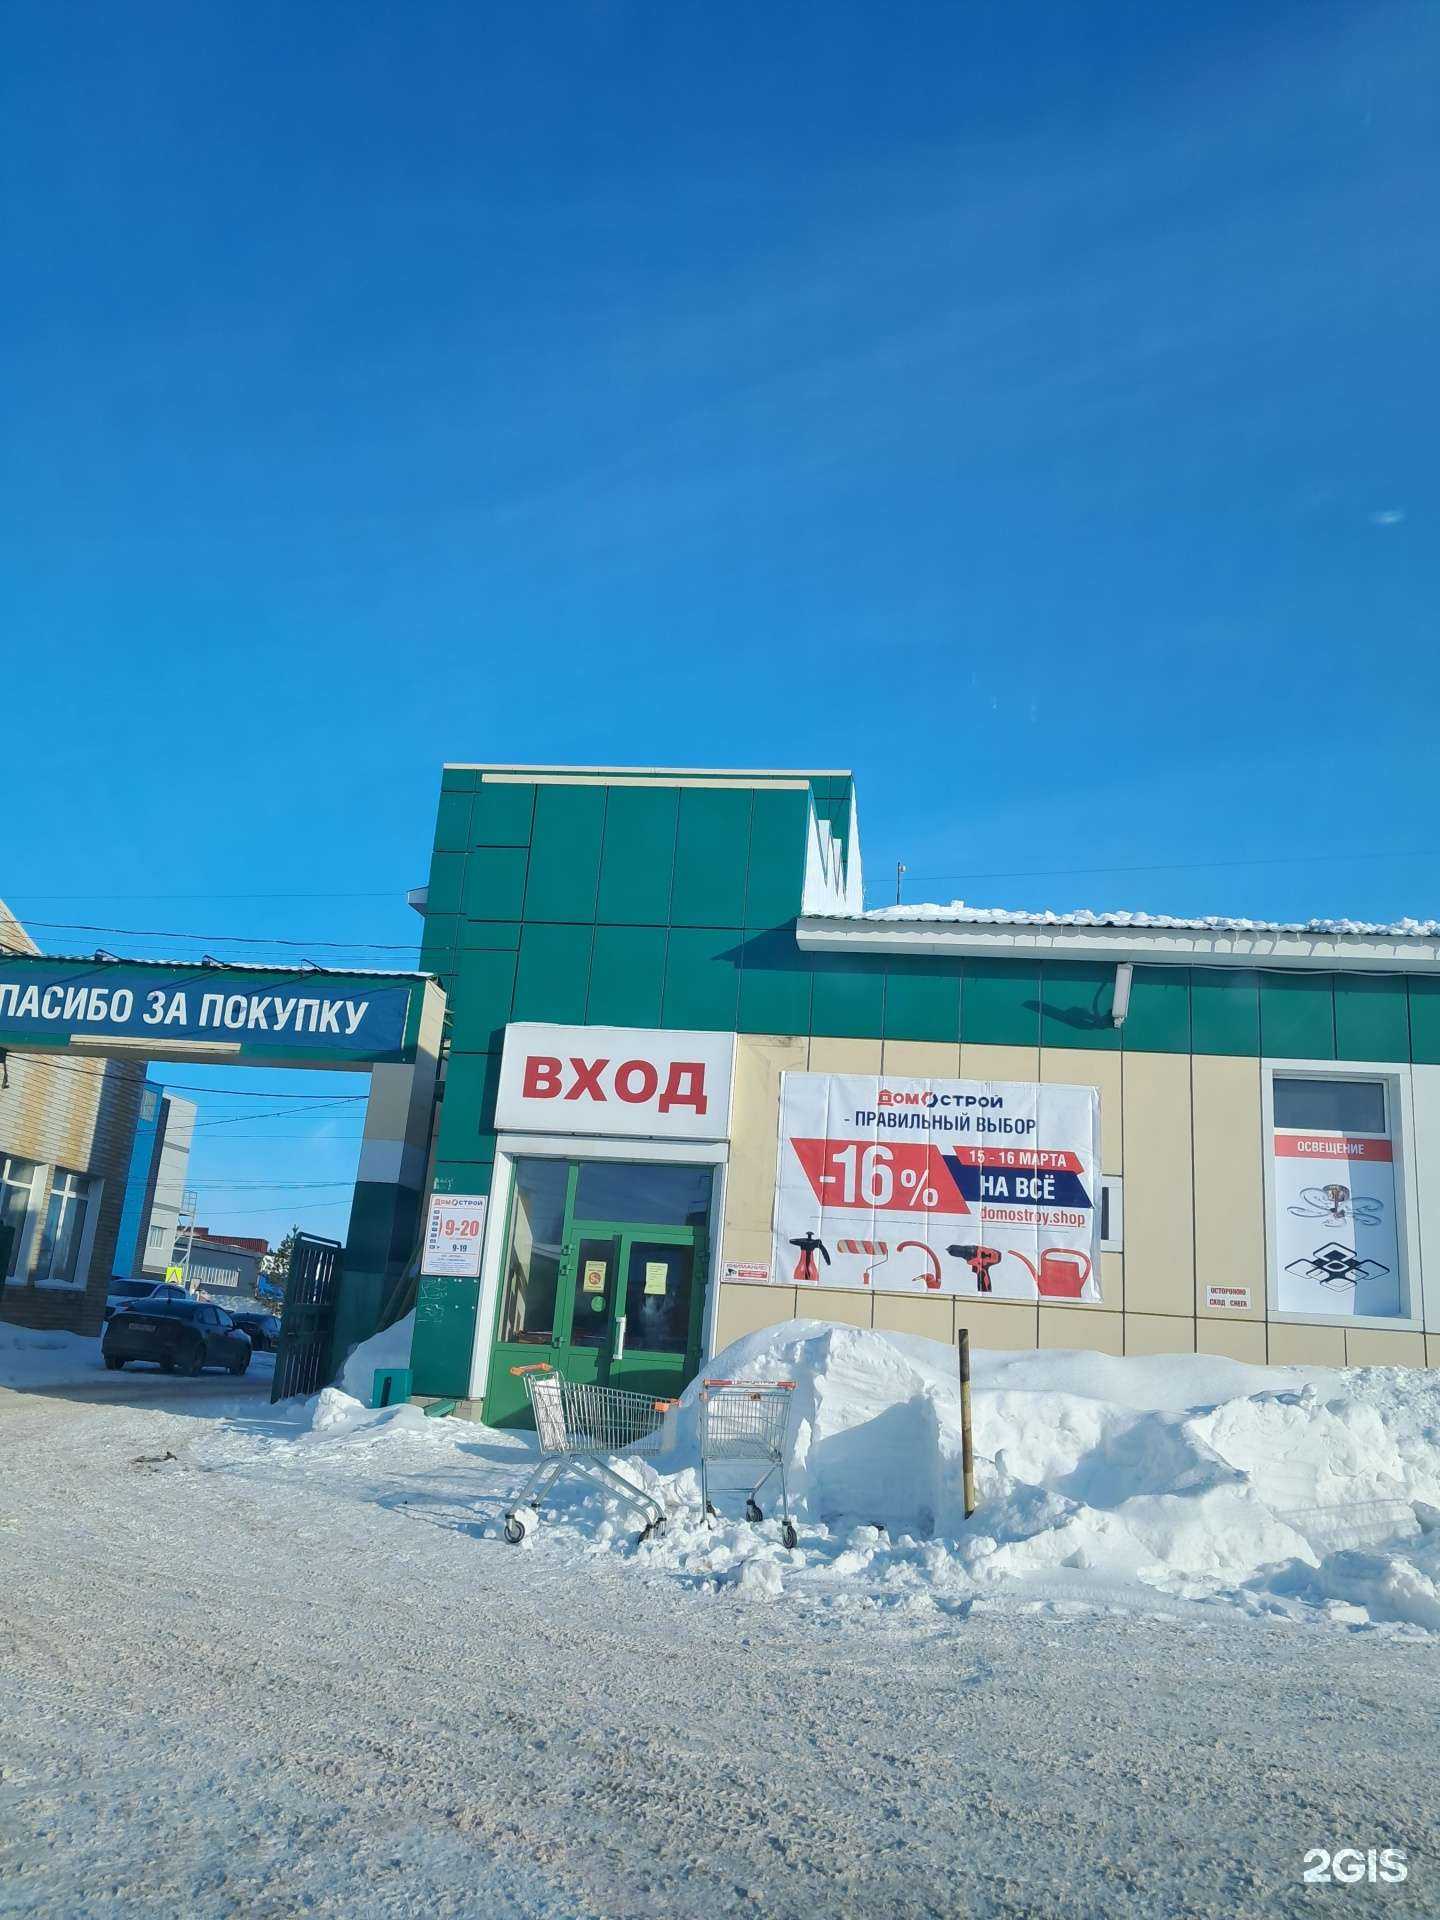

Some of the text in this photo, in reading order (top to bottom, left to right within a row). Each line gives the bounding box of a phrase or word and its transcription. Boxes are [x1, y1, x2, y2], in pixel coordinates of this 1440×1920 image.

[143, 990, 188, 1025] ЗА
[199, 993, 369, 1035] ПОКУПКУ
[522, 1055, 708, 1115] ВХОД
[855, 1110, 970, 1132] ПРАВИЛЬНЫЙ
[976, 1116, 1036, 1135] ВЫБОР
[970, 1150, 985, 1164] 15
[999, 1151, 1015, 1165] 16
[1019, 1152, 1067, 1168] МАРТА
[1297, 1141, 1366, 1155] ОСВЕЩЕНИЕ
[981, 1174, 1056, 1200] НА ВСЁ
[445, 1219, 480, 1236] 9-20
[981, 1206, 1086, 1227] domostroy.shop
